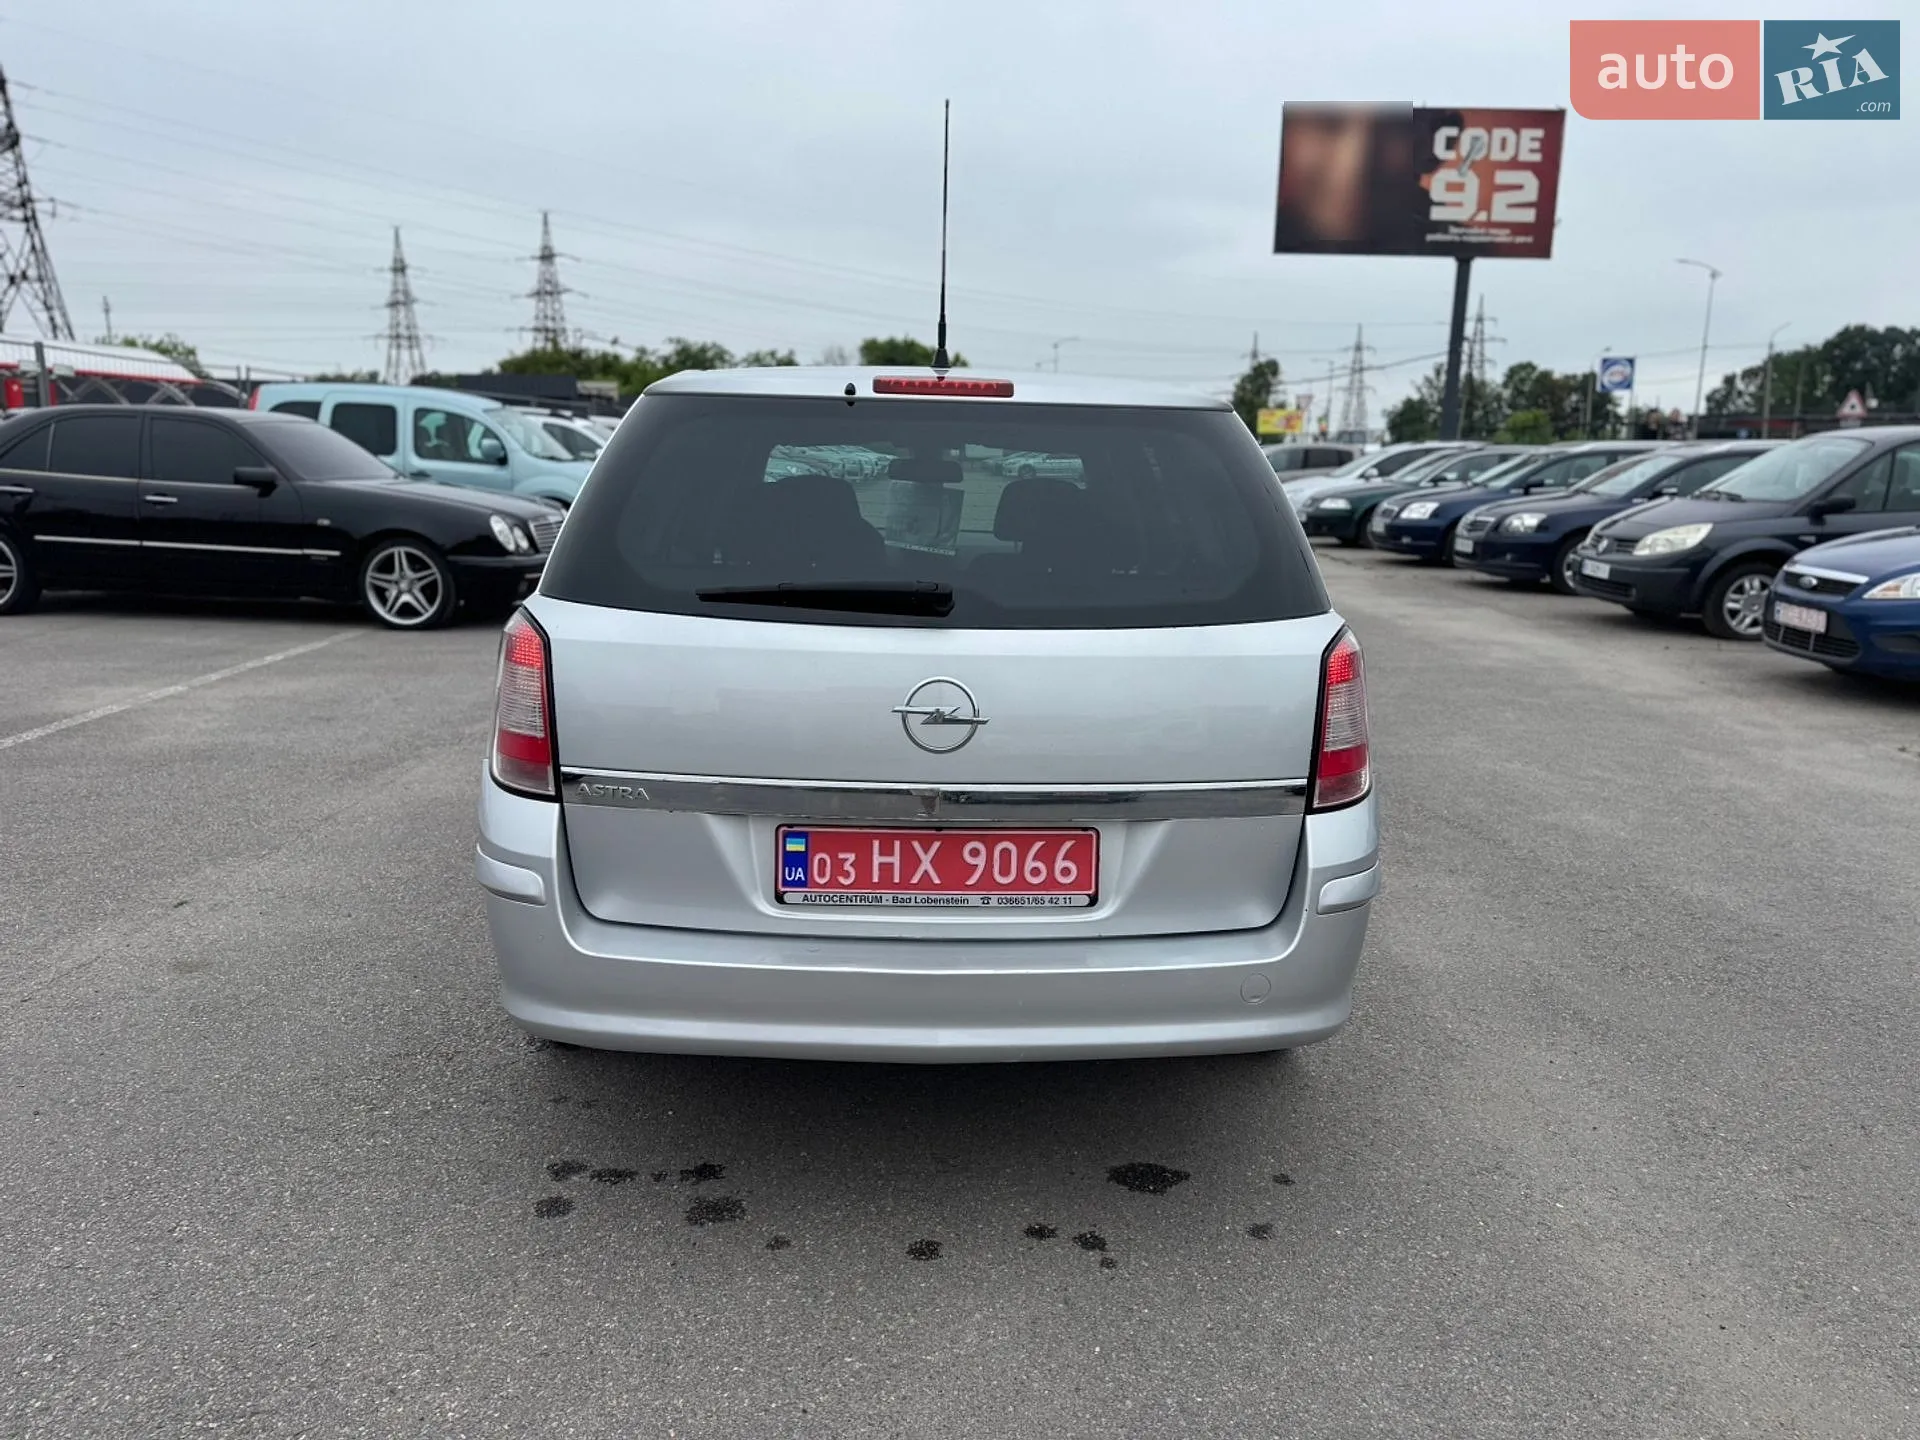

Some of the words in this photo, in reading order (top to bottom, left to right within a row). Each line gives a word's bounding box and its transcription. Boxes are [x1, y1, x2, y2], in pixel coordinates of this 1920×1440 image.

[1432, 126, 1545, 162] CODE
[1429, 168, 1540, 223] 9.2
[576, 782, 650, 800] ASTRA
[784, 866, 805, 881] UA
[812, 852, 857, 885] 03
[872, 839, 942, 885] HX
[963, 840, 1078, 885] 9066
[801, 894, 883, 904] AUTOCENTRUM
[892, 895, 912, 904] Bad
[914, 895, 969, 905] Lobenstein
